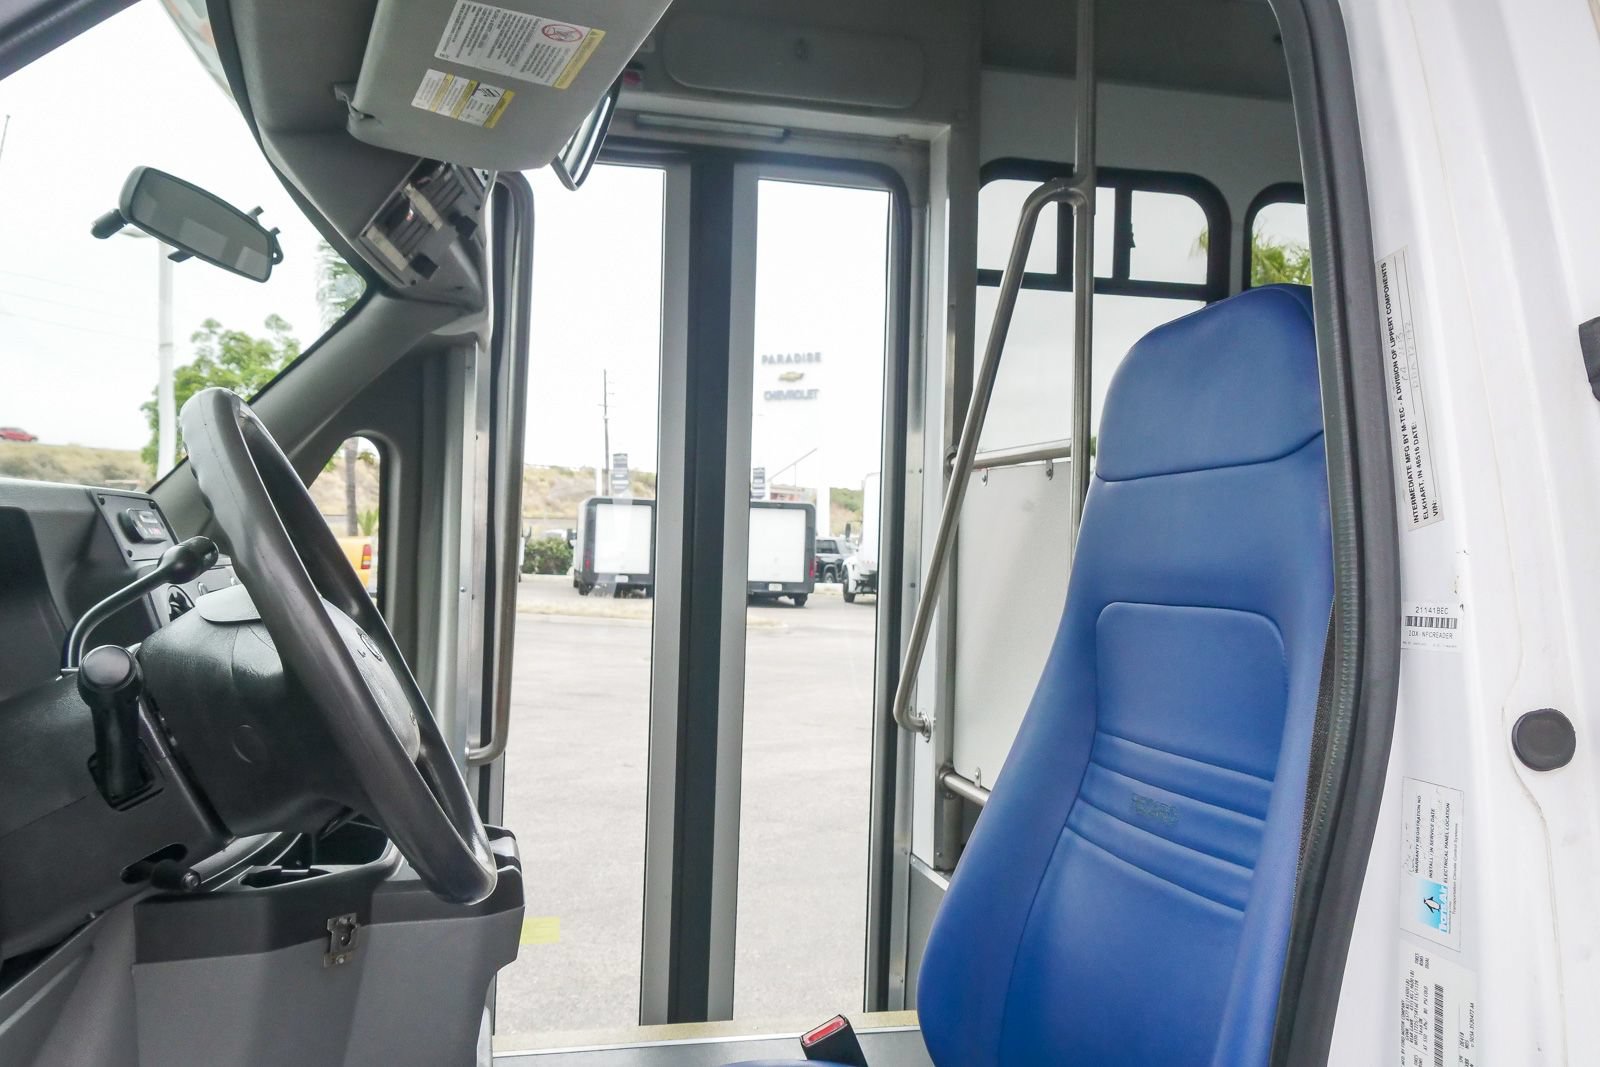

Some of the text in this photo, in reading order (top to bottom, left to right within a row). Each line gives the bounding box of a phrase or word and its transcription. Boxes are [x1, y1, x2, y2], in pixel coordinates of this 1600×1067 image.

[1381, 262, 1392, 314] COMPONENTS
[1386, 316, 1396, 347] LIPPERT
[762, 352, 821, 364] PARADISE
[1391, 349, 1398, 360] OF
[1393, 361, 1402, 394] DIVISION
[764, 389, 818, 400] CHEVROLET
[1402, 433, 1410, 444] BY
[1417, 470, 1423, 479] IN
[1406, 465, 1419, 523] INTERMEDIATE
